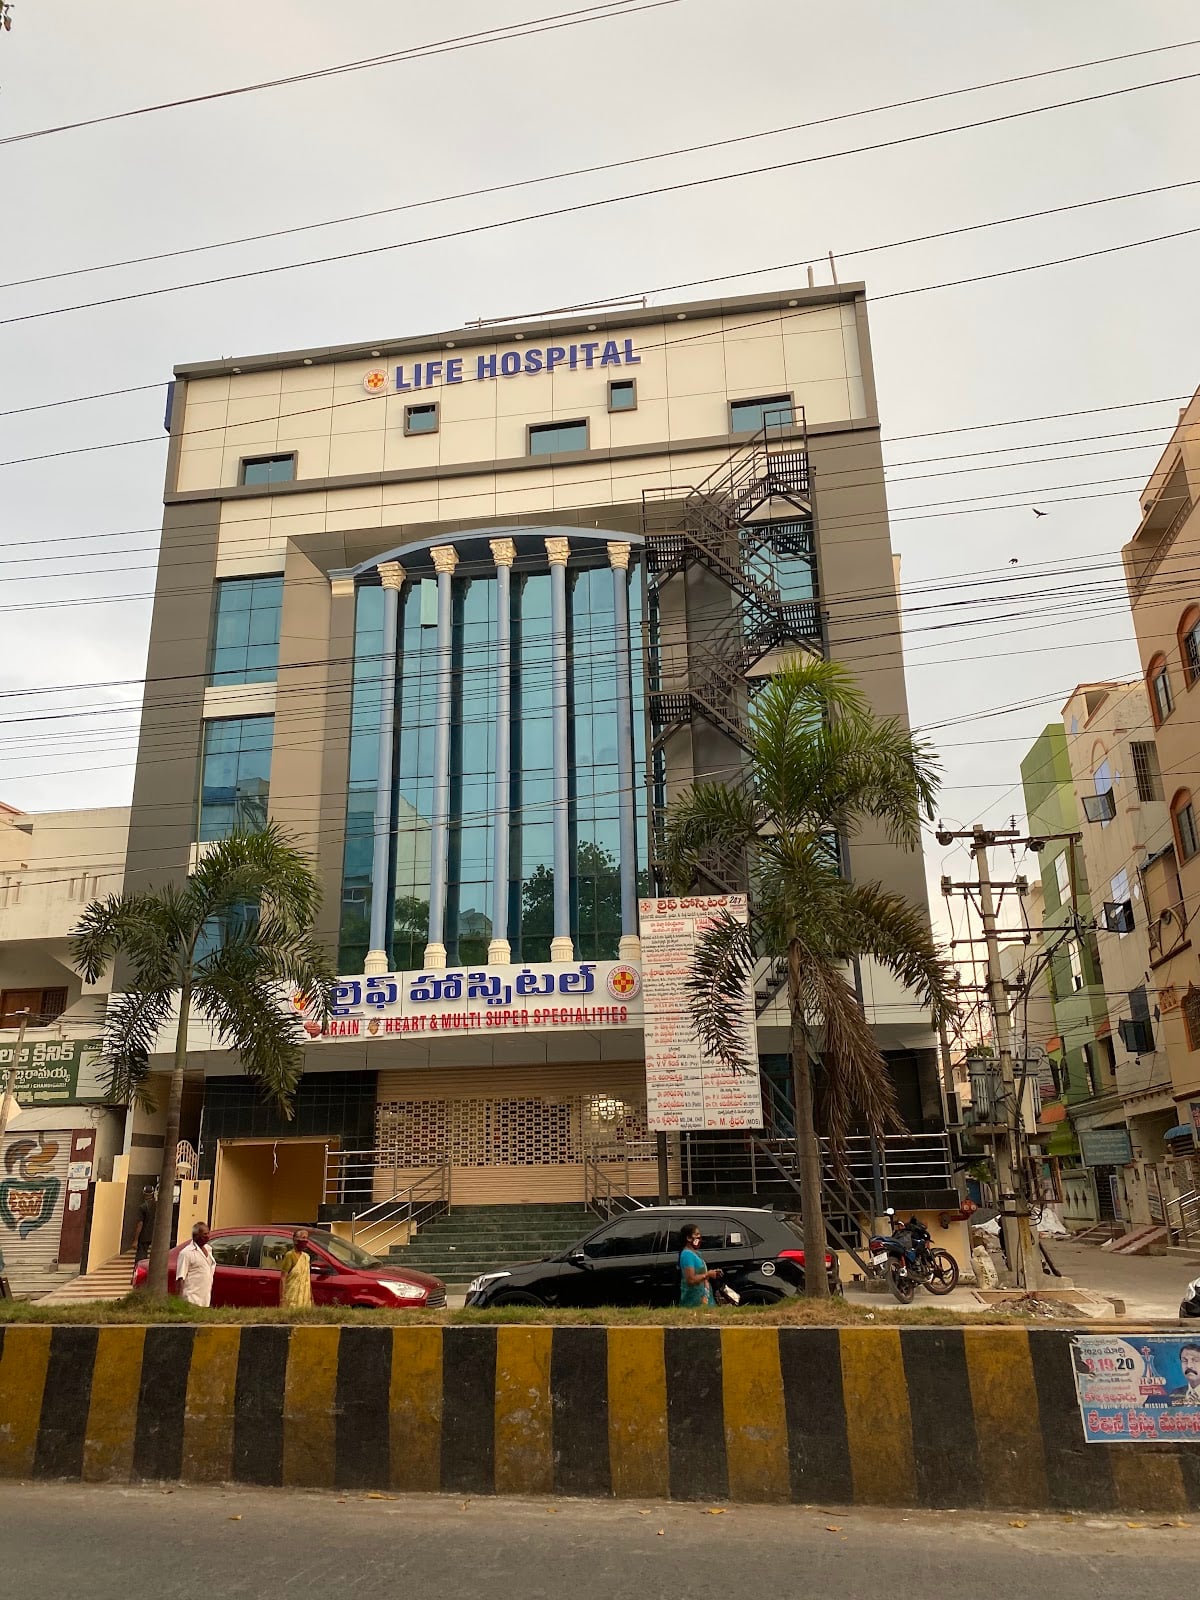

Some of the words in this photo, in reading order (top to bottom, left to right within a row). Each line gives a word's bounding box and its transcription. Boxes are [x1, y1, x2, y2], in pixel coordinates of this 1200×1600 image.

[396, 358, 463, 390] LIFE
[477, 339, 641, 381] HOSPITAL
[331, 975, 398, 1016] లైఫ్
[410, 964, 596, 1006] హాస్పిటల్
[385, 1015, 427, 1032] HEART
[430, 1014, 438, 1030] &
[442, 1012, 481, 1029] MULTI
[486, 1009, 528, 1026] SUPER
[534, 1006, 628, 1024] SPECIALITIES
[32, 1041, 76, 1067] క్లినిక్
